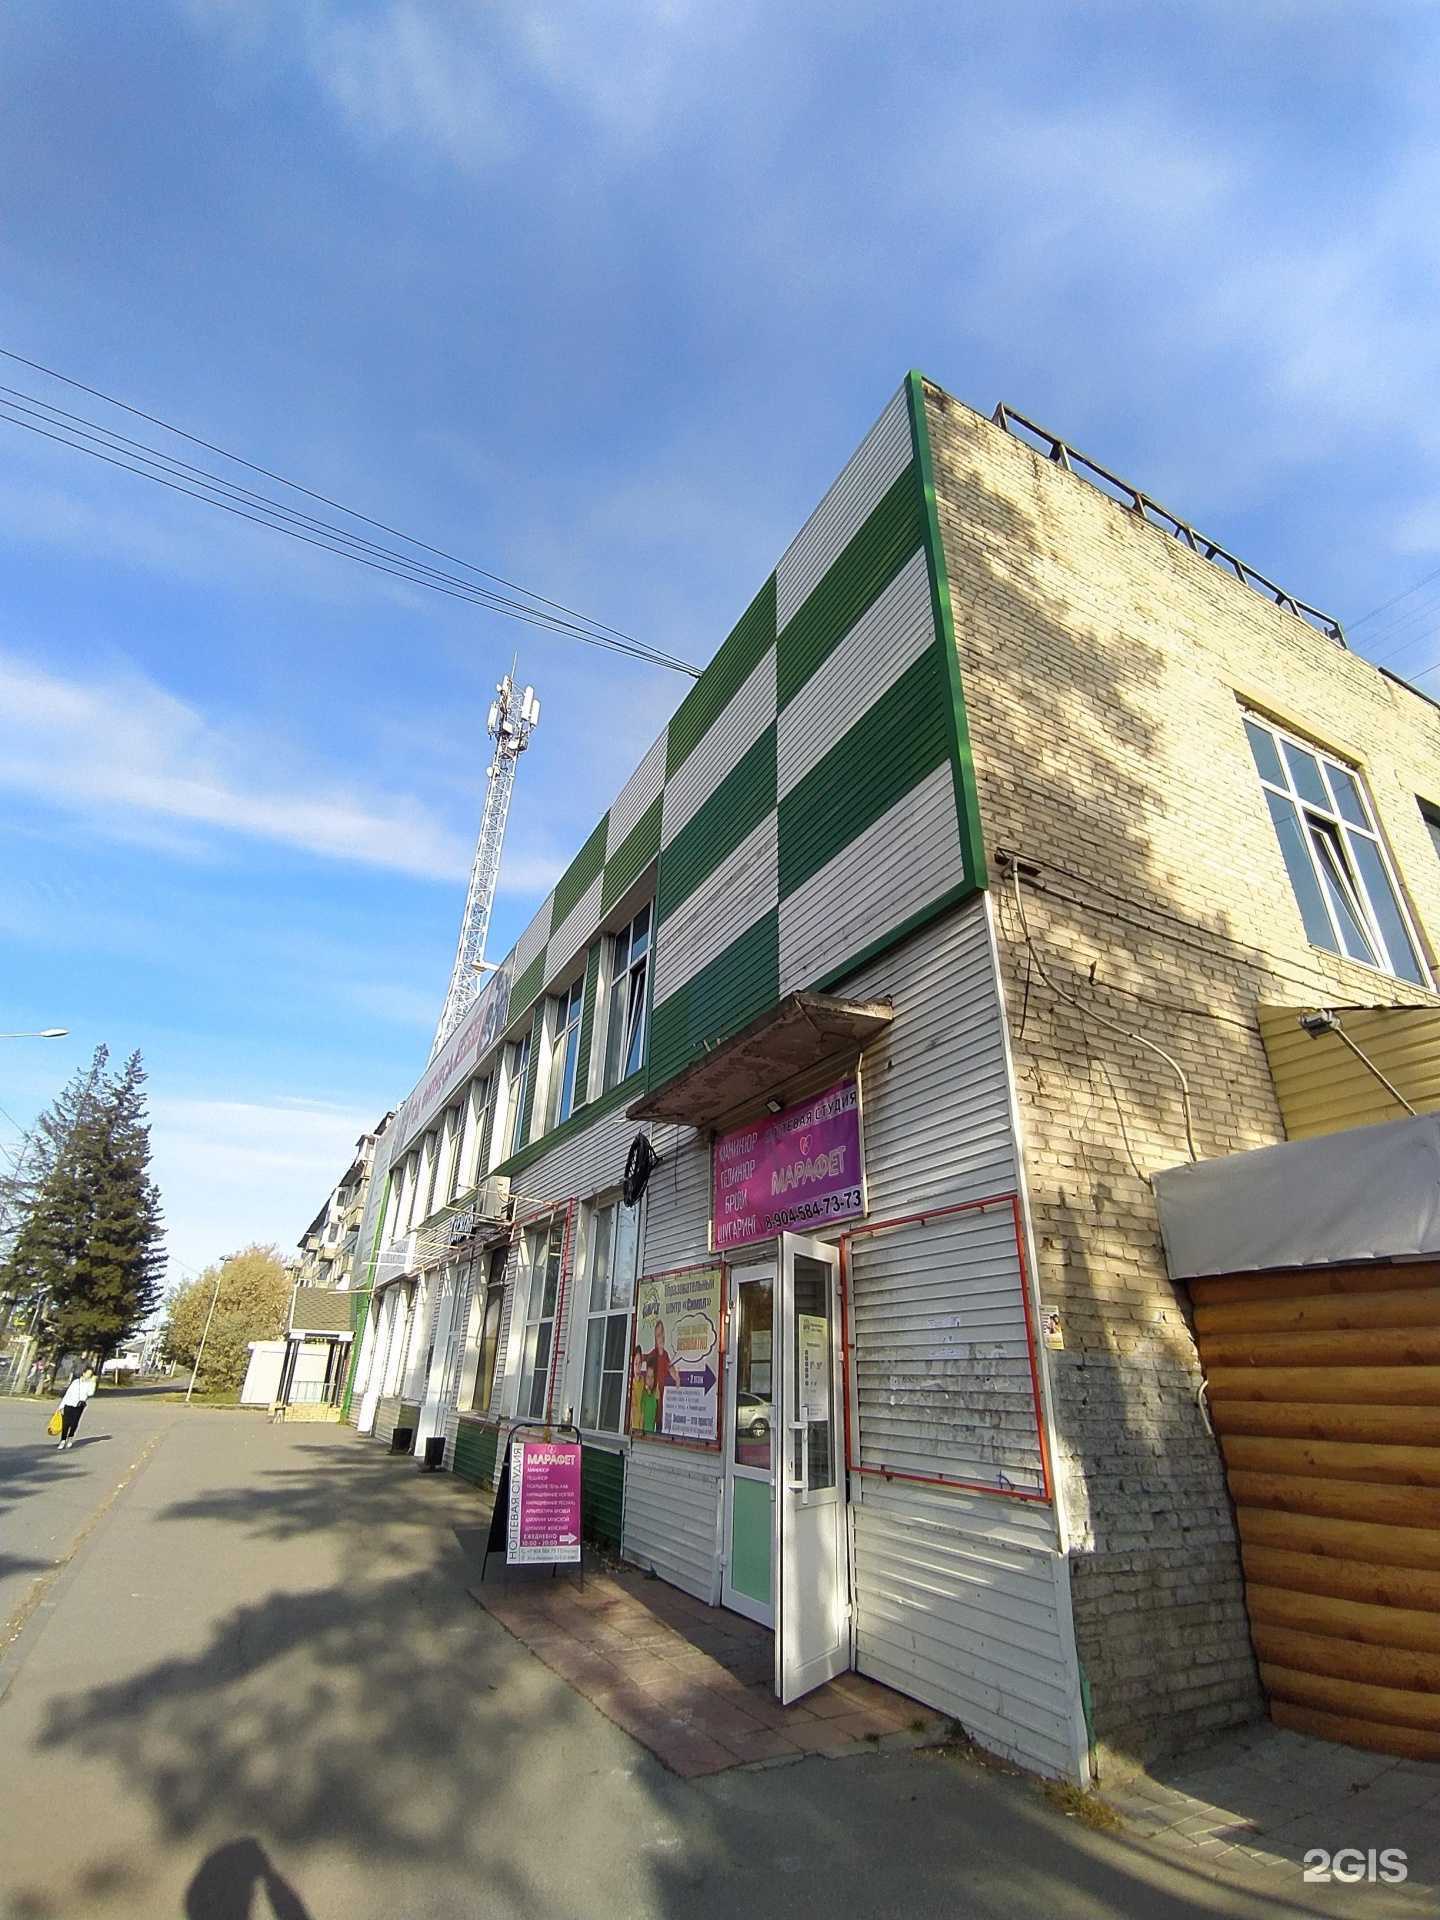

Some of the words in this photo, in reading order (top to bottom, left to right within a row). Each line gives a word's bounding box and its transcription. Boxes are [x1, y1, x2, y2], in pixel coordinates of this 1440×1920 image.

[815, 1090, 858, 1121] СТУДИЯ
[771, 1146, 847, 1196] МАРАФЕТ
[724, 1187, 749, 1215] БРОВИ
[764, 1190, 862, 1230] 8-904-584-73-73
[717, 1215, 758, 1244] ШУГАРИНГ
[512, 1447, 523, 1495] СТУДИЯ
[527, 1454, 577, 1466] МАРАФЕТ
[509, 1498, 521, 1561] НОГТЕВАЯ
